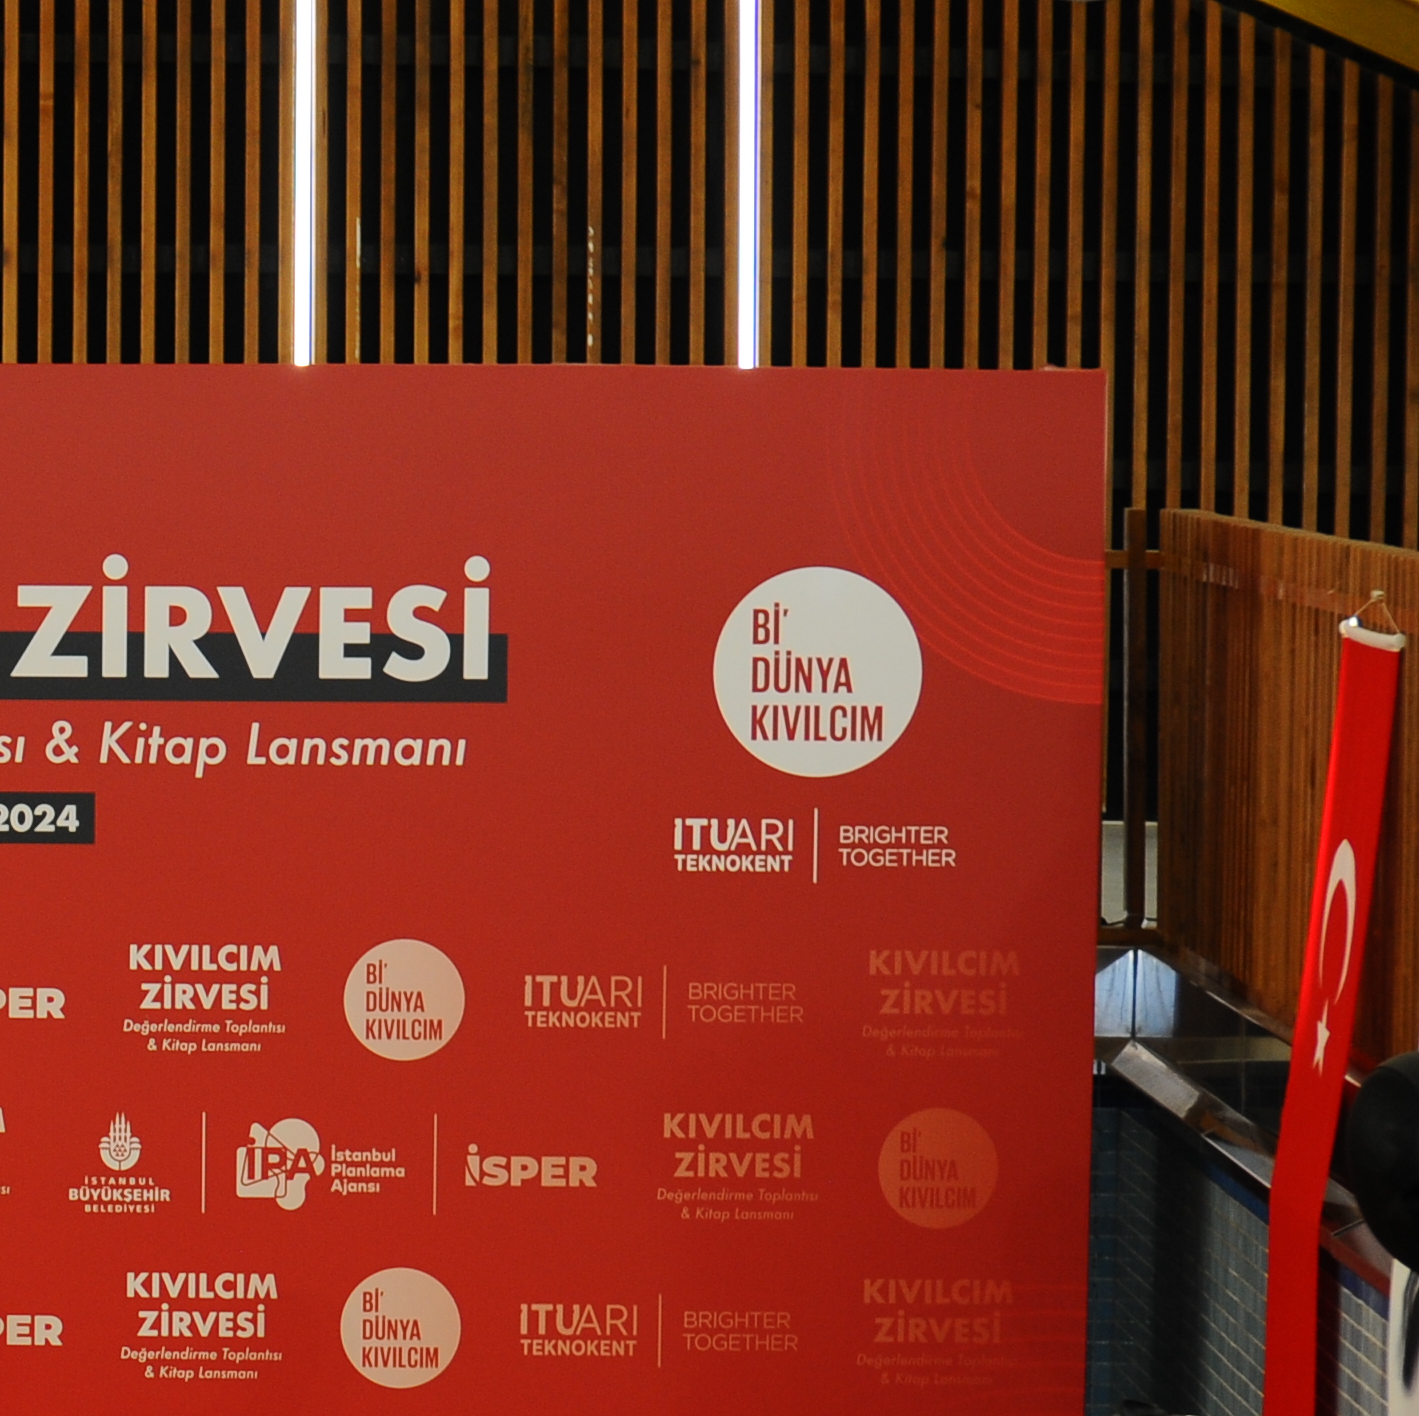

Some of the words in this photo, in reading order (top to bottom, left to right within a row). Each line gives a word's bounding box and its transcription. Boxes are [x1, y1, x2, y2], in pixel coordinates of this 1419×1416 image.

[11, 554, 490, 681] ZİRVESİ
[753, 652, 851, 692] DÜNYA
[753, 706, 882, 740] KIVILCIM
[46, 721, 78, 763] &
[100, 721, 226, 778] Kitap
[247, 722, 466, 765] Lansmanı
[840, 825, 948, 844] BRIGHTER
[674, 855, 792, 871] TEKNOKENT
[839, 848, 956, 866] TOGETHER
[130, 944, 281, 971] KIVILCIM
[140, 975, 268, 1010] ZİRVESİ
[367, 988, 424, 1011] DÜNYA
[689, 982, 795, 1000] BRIGHTER
[525, 1011, 641, 1027] TEKNOKENT
[687, 1005, 803, 1023] TOGETHER
[123, 1019, 220, 1035] Değerlendirme
[226, 1020, 285, 1036] Toplantısı
[367, 1020, 442, 1039] KIVILCIM
[147, 1038, 157, 1050] &
[162, 1039, 197, 1055] Kitap
[664, 1113, 813, 1139] KIVILCIM
[332, 1144, 395, 1162] İstanbul
[674, 1144, 800, 1177] ZİRVESİ
[331, 1163, 405, 1177] Planlama
[465, 1144, 597, 1186] İSPER
[69, 1186, 170, 1202] BÜYÜKŞEHİR
[331, 1180, 380, 1195] Ajansı
[127, 1272, 277, 1299] KIVILCIM
[138, 1303, 264, 1337] ZİRVESİ
[363, 1317, 420, 1339] DÜNYA
[121, 1346, 217, 1362] Değerlendirme
[223, 1348, 282, 1363] Toplantısı
[520, 1339, 636, 1356] TEKNOKENT
[363, 1348, 438, 1367] KIVILCIM
[145, 1365, 154, 1378] &
[160, 1366, 194, 1381] Kitap
